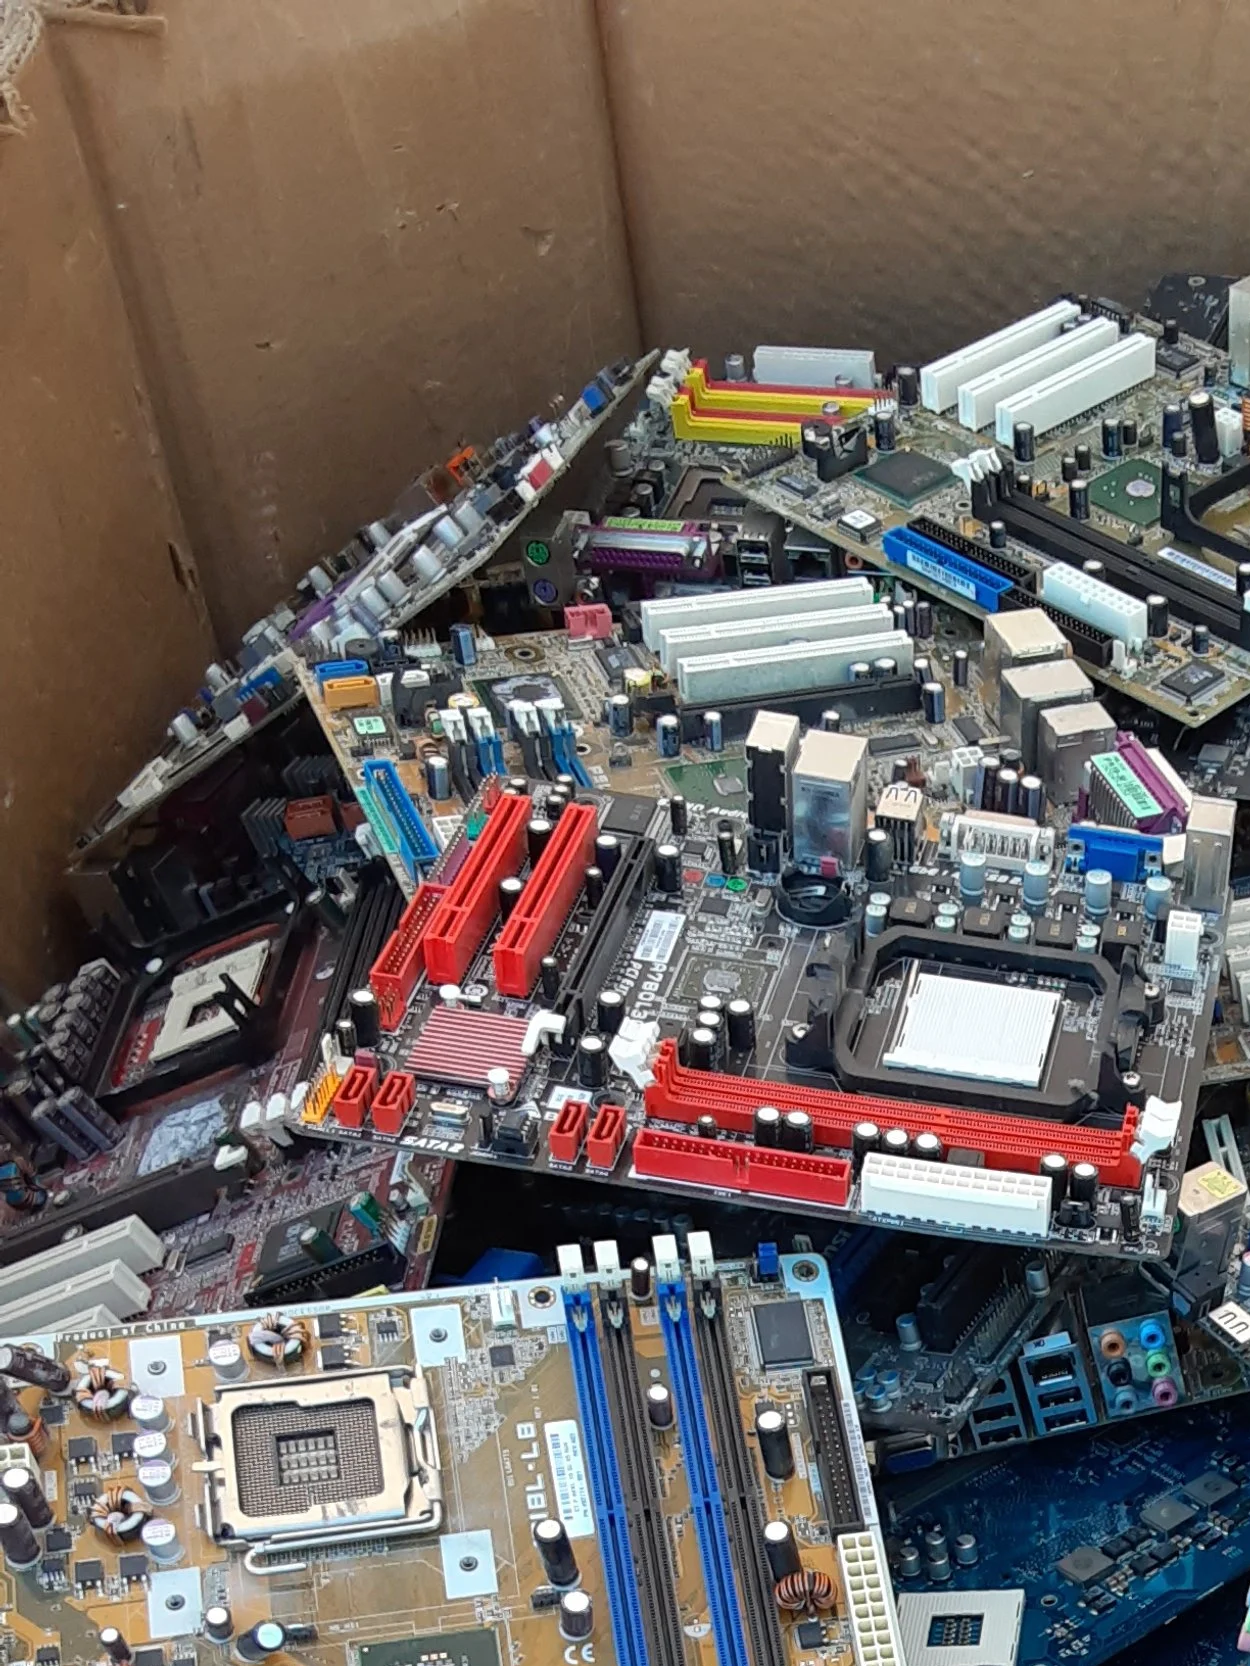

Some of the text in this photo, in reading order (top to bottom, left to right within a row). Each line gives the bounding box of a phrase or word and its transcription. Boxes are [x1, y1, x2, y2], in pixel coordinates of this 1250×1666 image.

[55, 1319, 186, 1344] Product of China
[563, 1642, 595, 1665] CE
